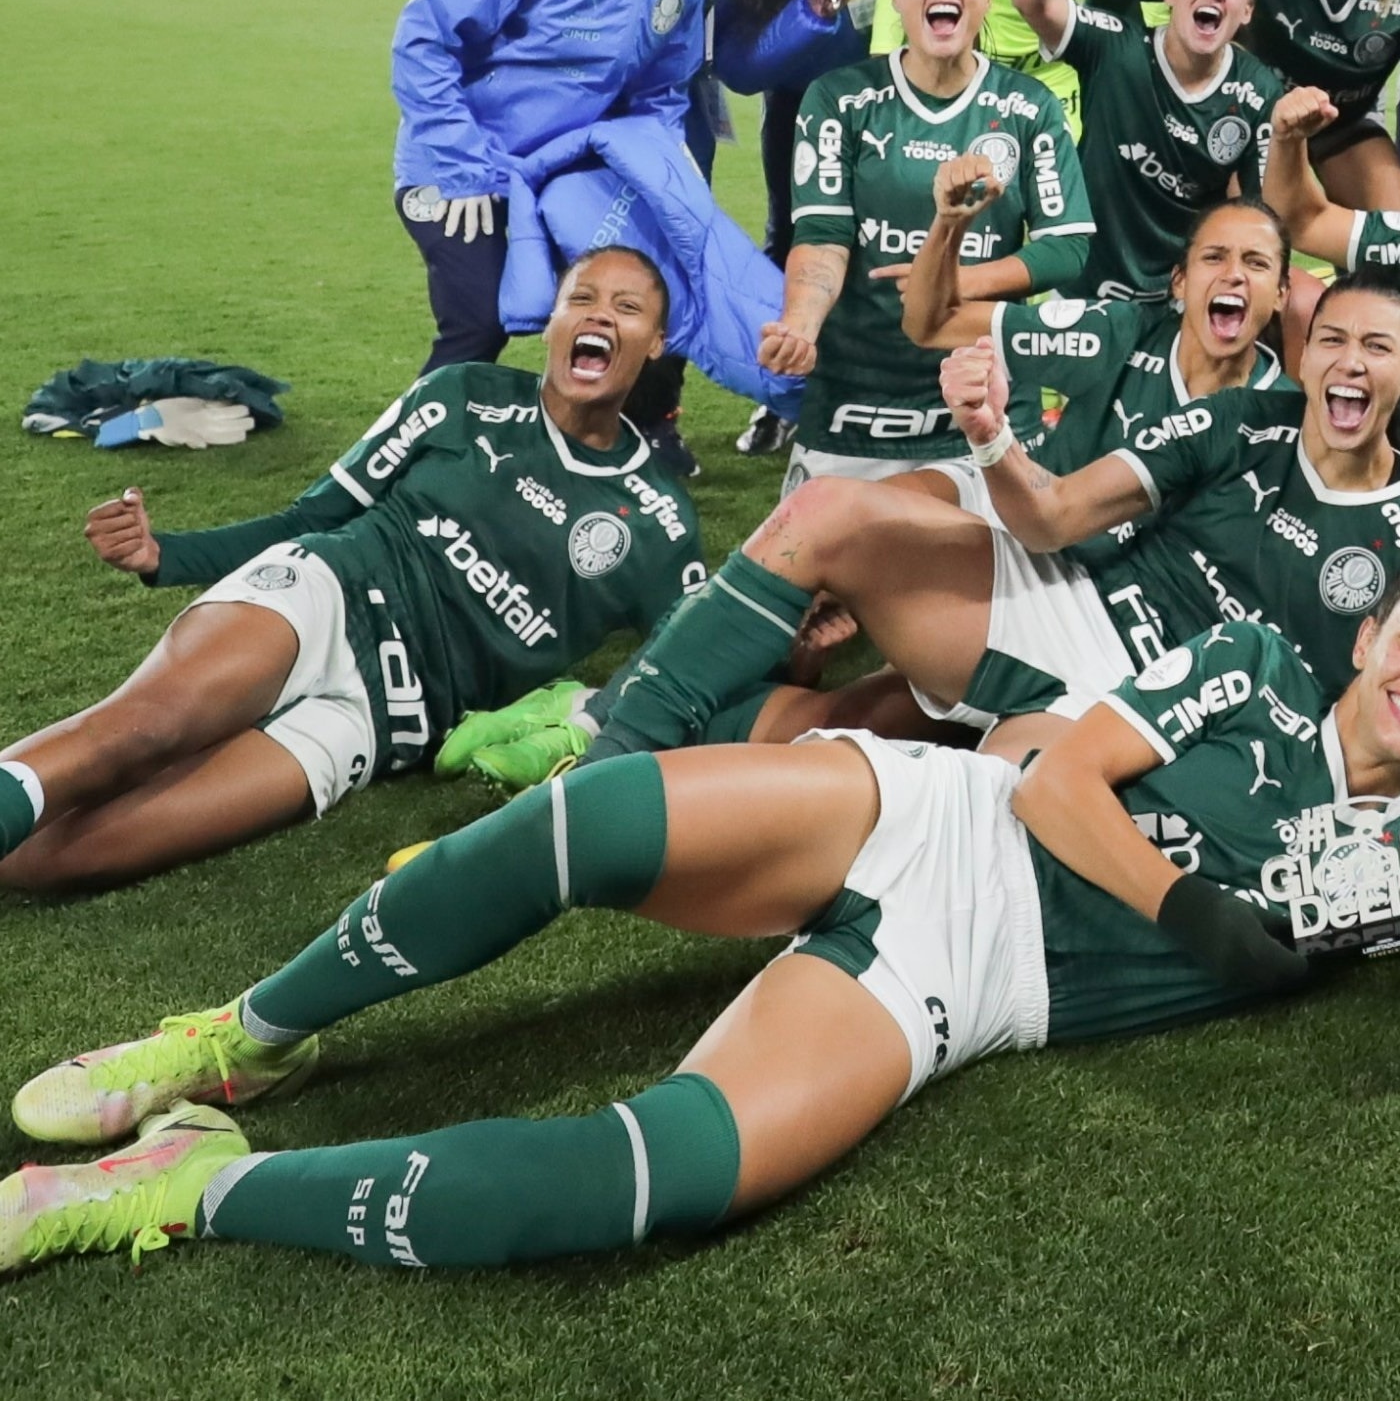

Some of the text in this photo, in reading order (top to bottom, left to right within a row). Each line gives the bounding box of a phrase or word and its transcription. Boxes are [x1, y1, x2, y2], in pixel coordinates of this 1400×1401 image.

[1309, 35, 1348, 55] TODOS
[977, 91, 1040, 120] crefisa
[818, 118, 843, 195] CIMED
[902, 146, 958, 161] TODOS
[1033, 133, 1065, 218] CIMED
[1011, 332, 1101, 357] CIMED
[366, 401, 447, 479] CIMED
[515, 478, 568, 526] TODOS
[624, 474, 687, 542] crefisa
[572, 526, 618, 573] PALMEIRAS
[1266, 513, 1320, 557] TODOS
[444, 531, 558, 648] betfair
[1324, 563, 1376, 610] PALMEIRAS
[336, 913, 361, 967] SEP
[346, 1177, 375, 1246] SEP
